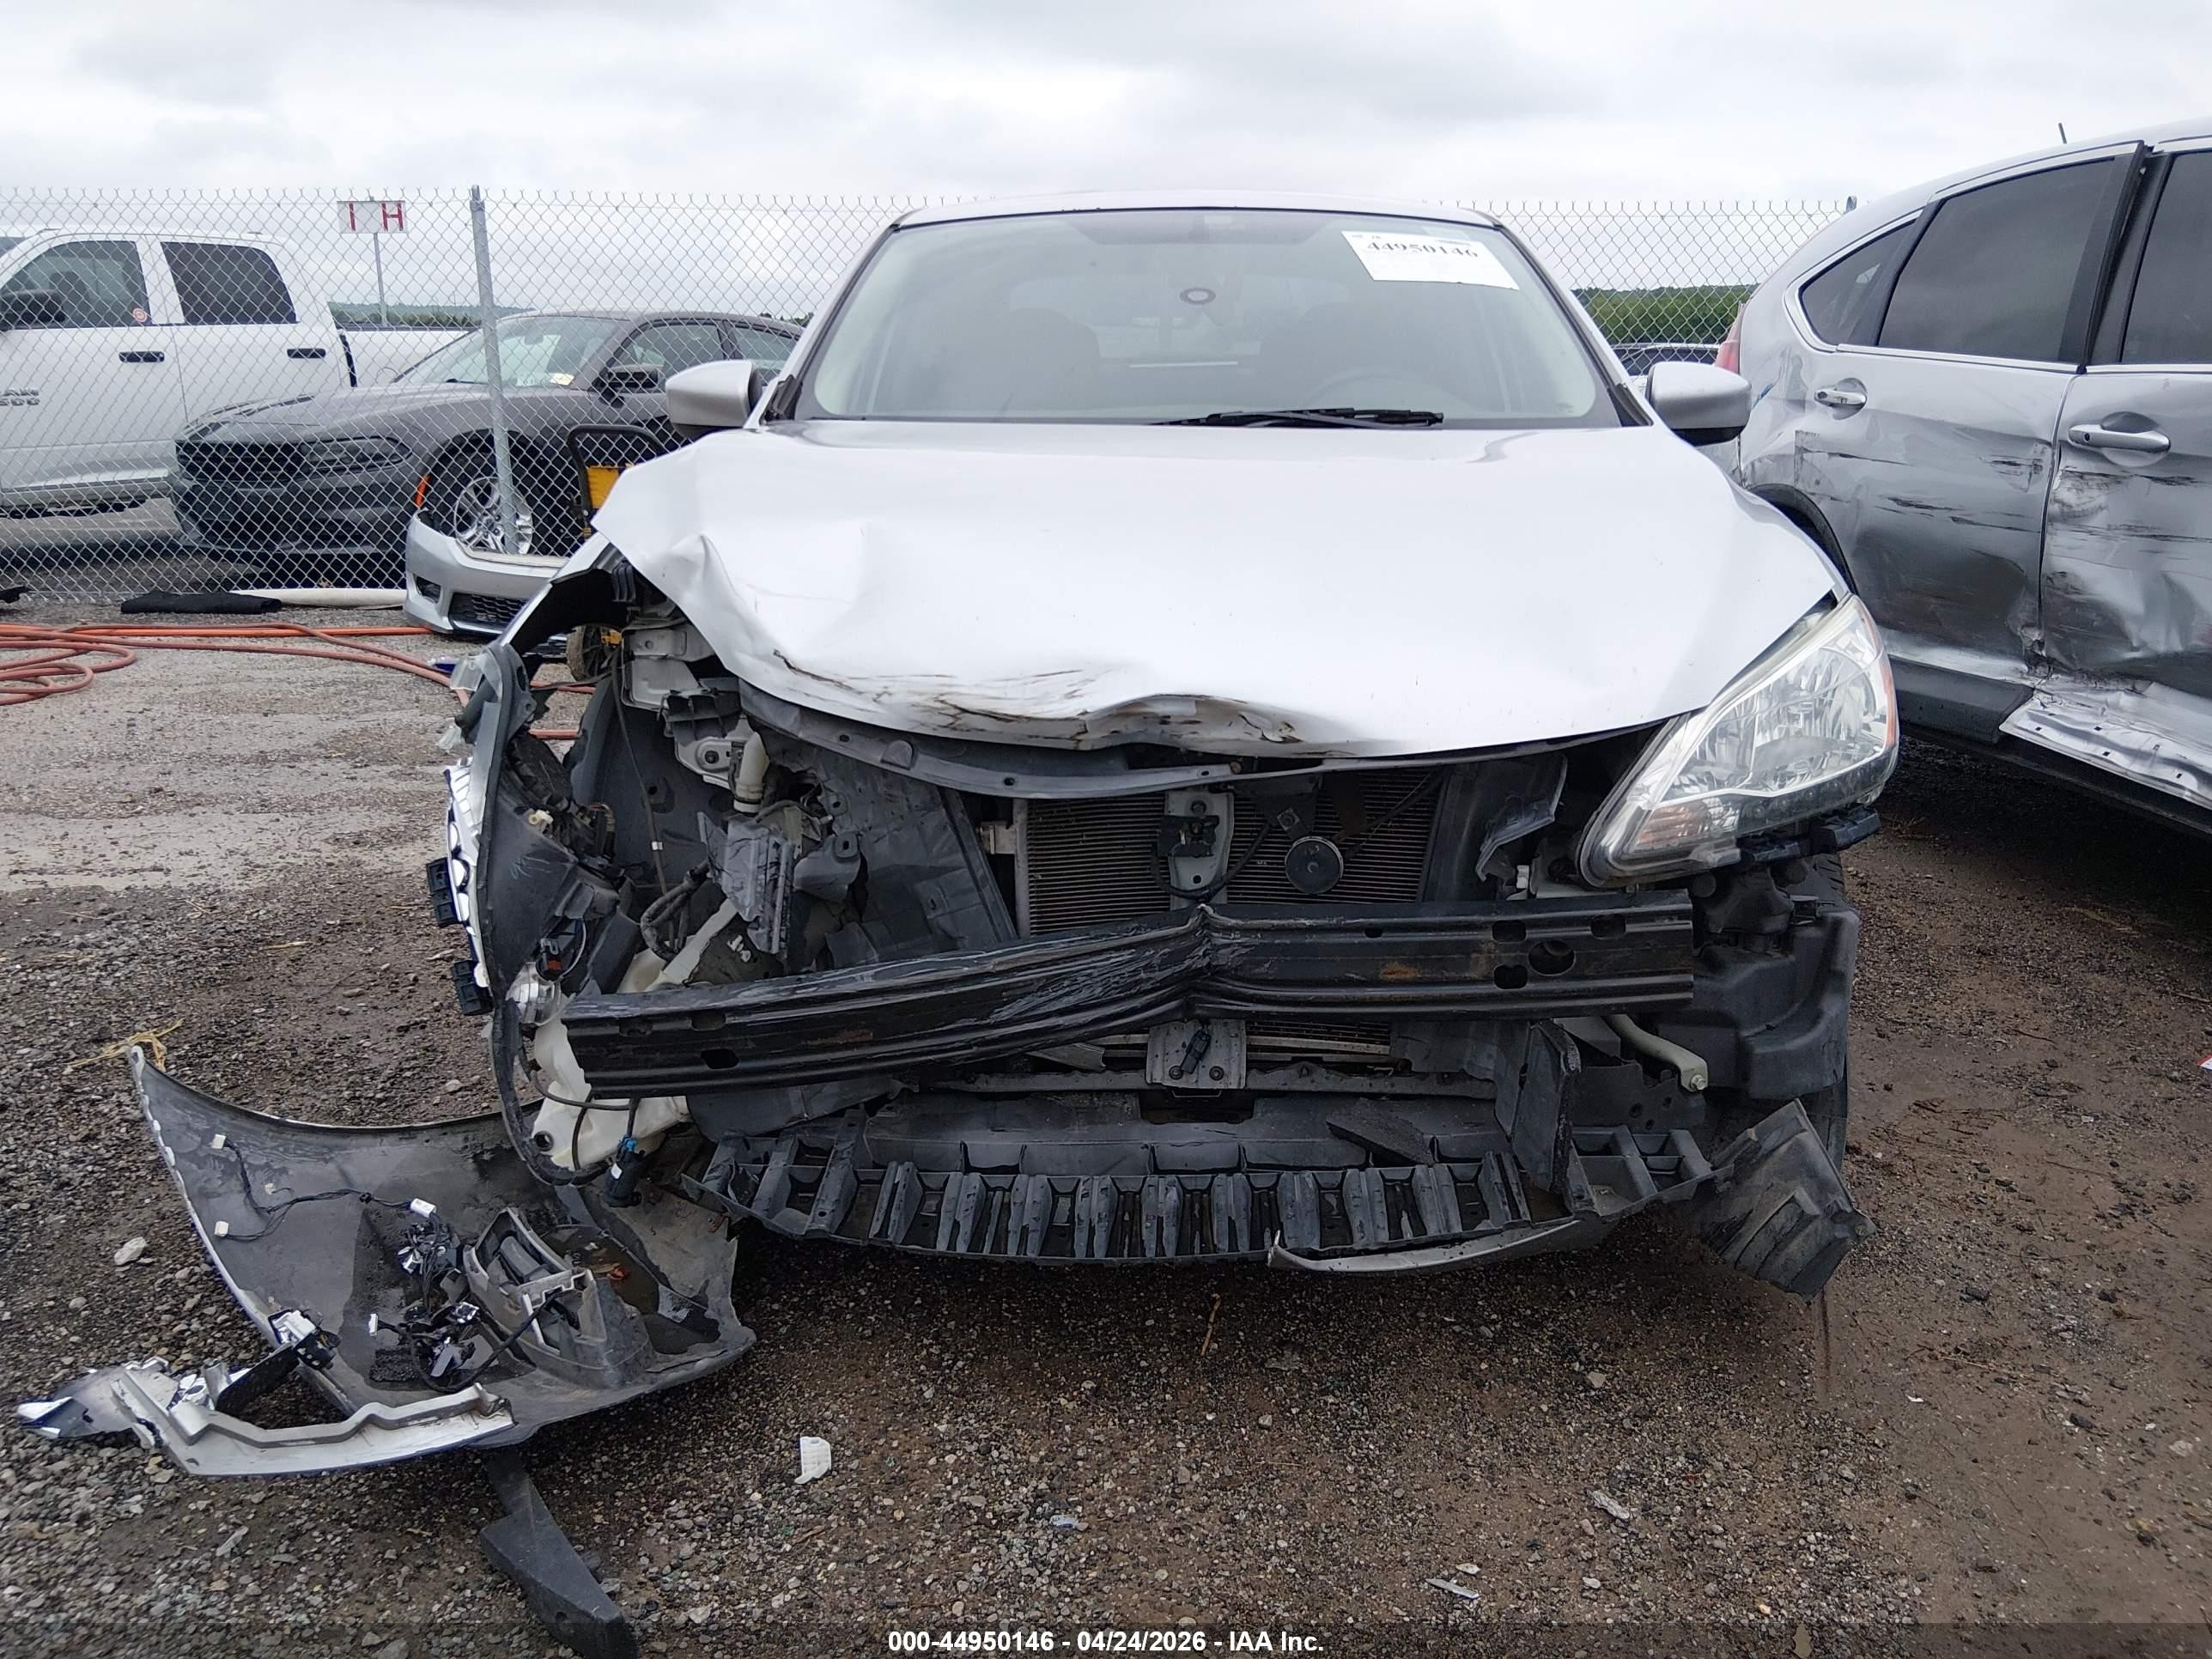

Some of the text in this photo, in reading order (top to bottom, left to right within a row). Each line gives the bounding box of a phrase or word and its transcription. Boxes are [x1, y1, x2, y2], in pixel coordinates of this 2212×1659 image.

[381, 203, 404, 231] H
[1367, 241, 1478, 258] 44950146
[0, 387, 40, 397] AM
[0, 398, 40, 406] 500
